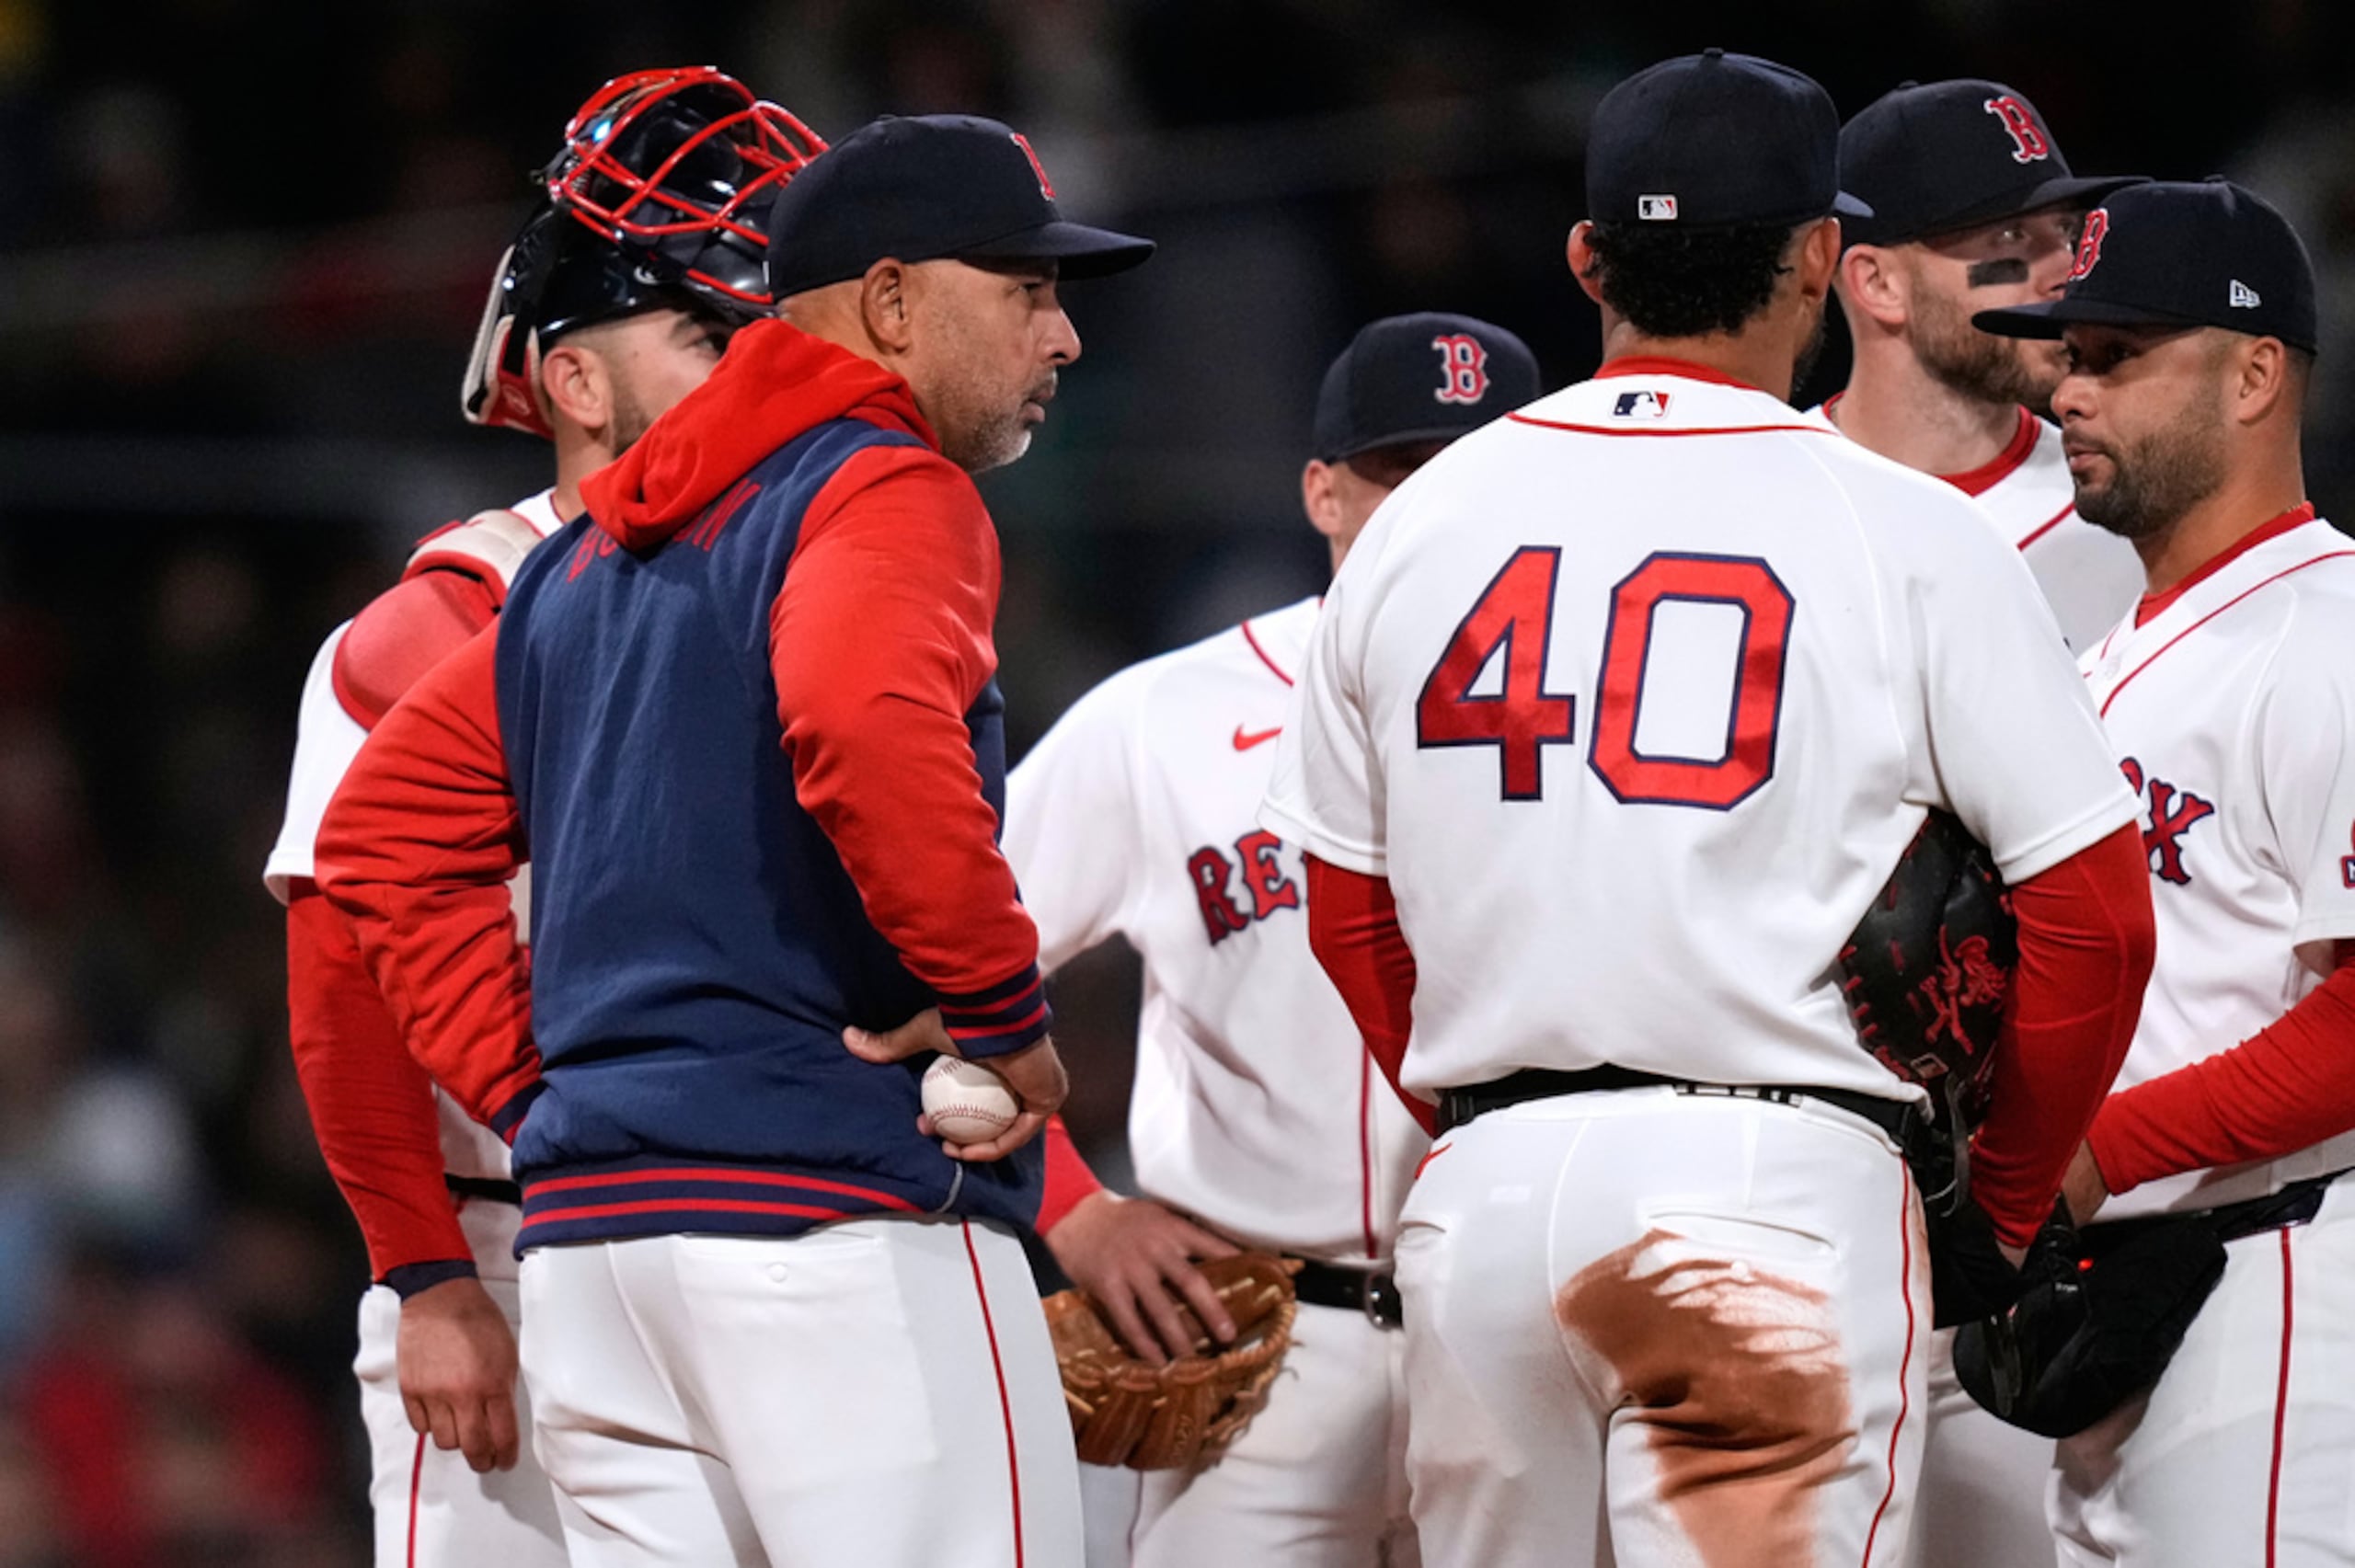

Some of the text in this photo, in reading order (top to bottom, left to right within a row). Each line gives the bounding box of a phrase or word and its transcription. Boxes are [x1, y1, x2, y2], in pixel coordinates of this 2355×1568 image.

[1983, 95, 2049, 164] B
[2069, 208, 2110, 280] B
[1431, 334, 1490, 405] B
[1417, 545, 1796, 811] 40
[1187, 828, 1309, 947] RE
